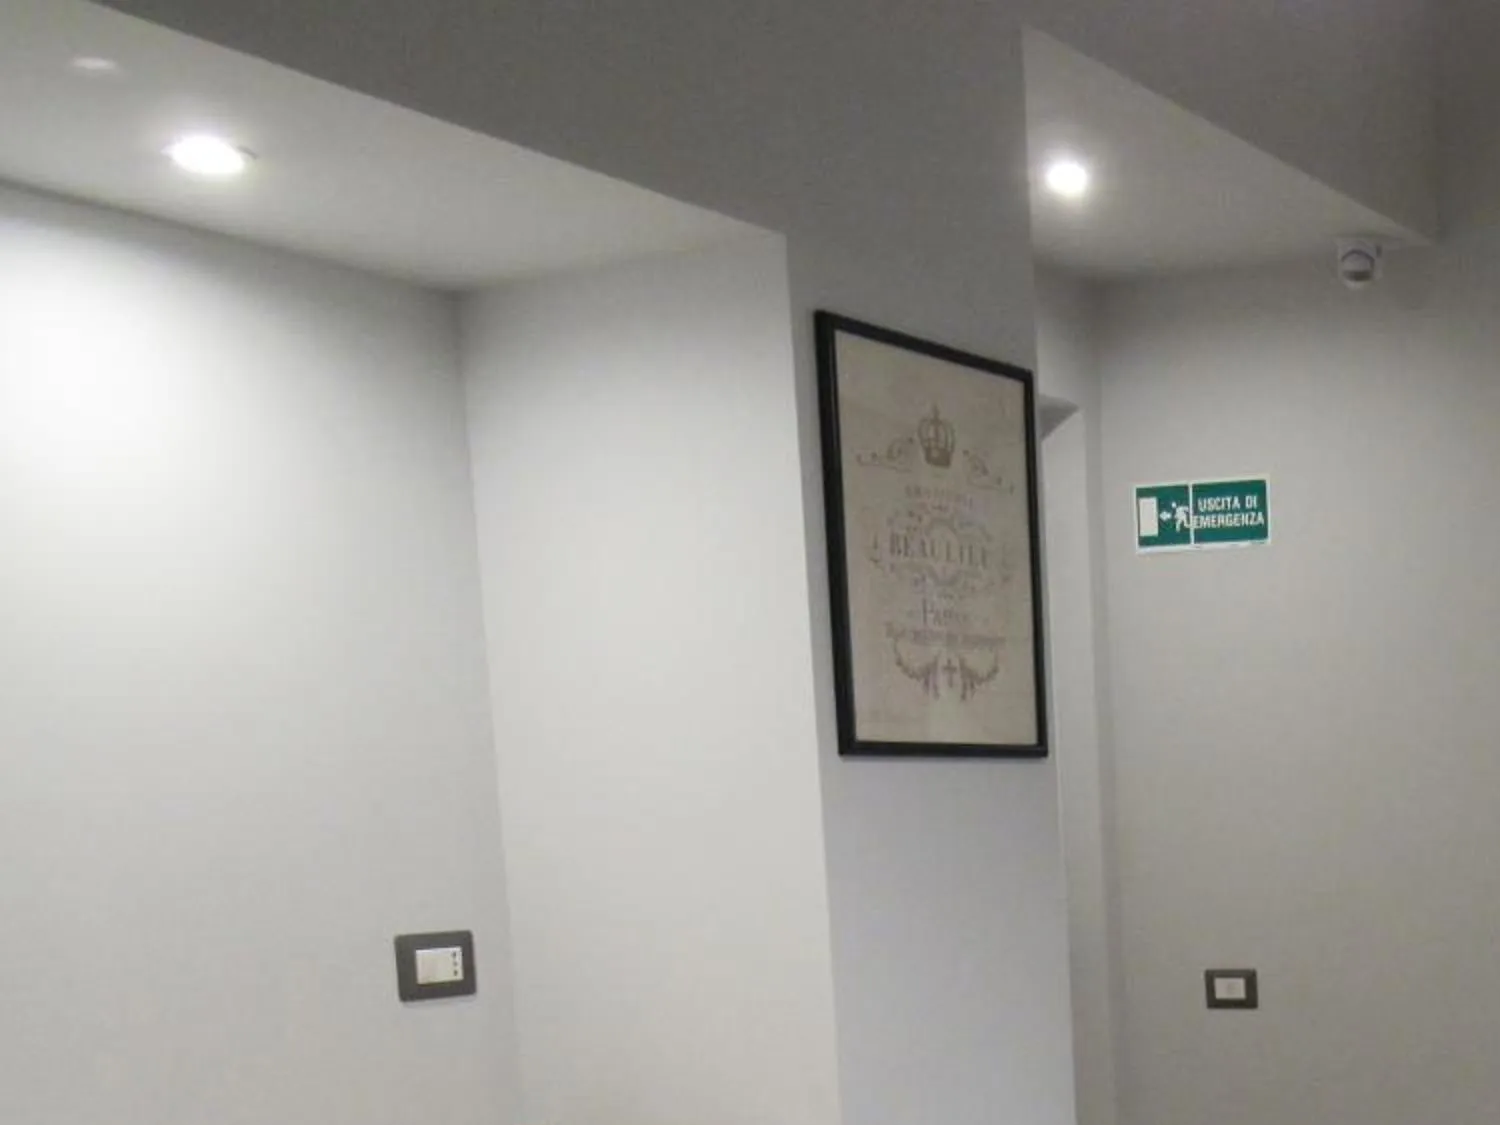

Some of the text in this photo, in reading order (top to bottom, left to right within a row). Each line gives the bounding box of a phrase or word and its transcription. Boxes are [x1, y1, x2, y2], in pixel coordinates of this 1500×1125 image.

[1198, 494, 1258, 513] USCITA DI
[1193, 511, 1265, 529] EMERGENZA
